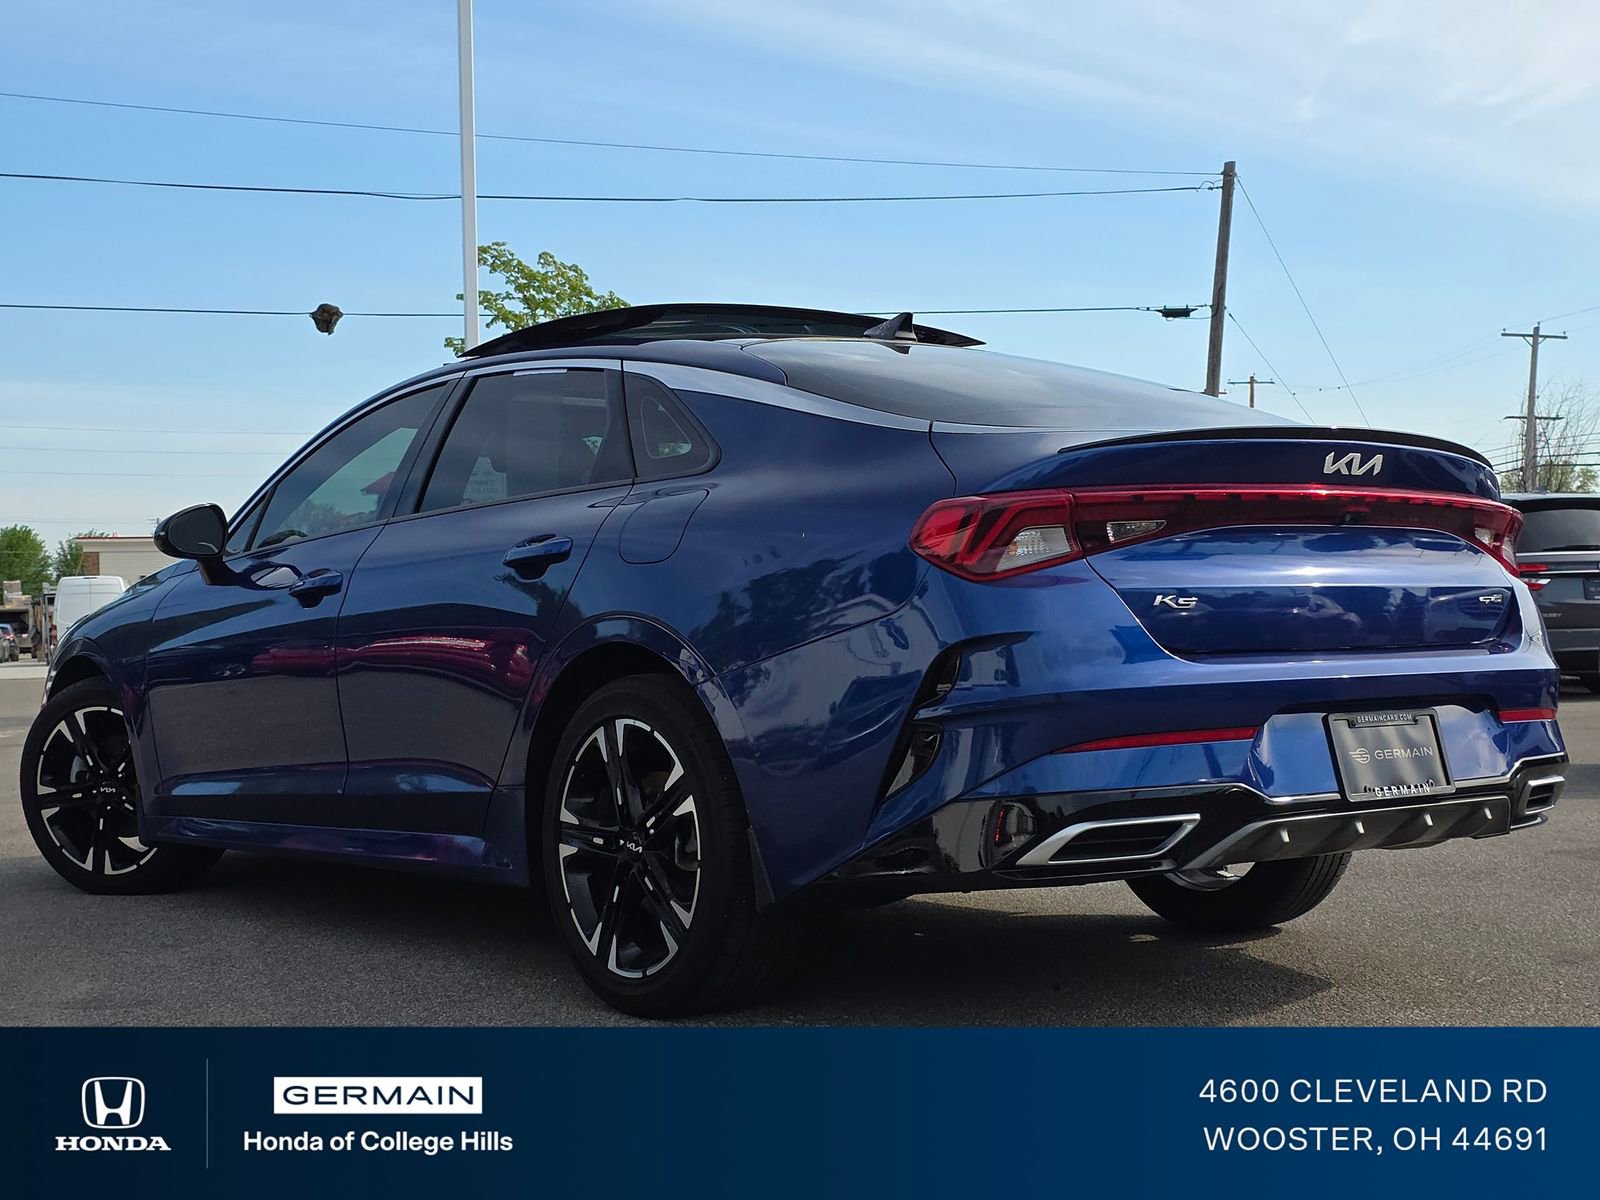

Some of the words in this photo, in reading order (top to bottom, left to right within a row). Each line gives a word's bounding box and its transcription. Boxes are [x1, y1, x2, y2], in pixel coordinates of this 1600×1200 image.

[1323, 451, 1383, 476] KIA
[1153, 594, 1199, 609] K5
[1357, 713, 1413, 723] GERMAINCARS.COM
[1374, 746, 1434, 760] GERMAIN
[1375, 783, 1431, 797] GERMAIN
